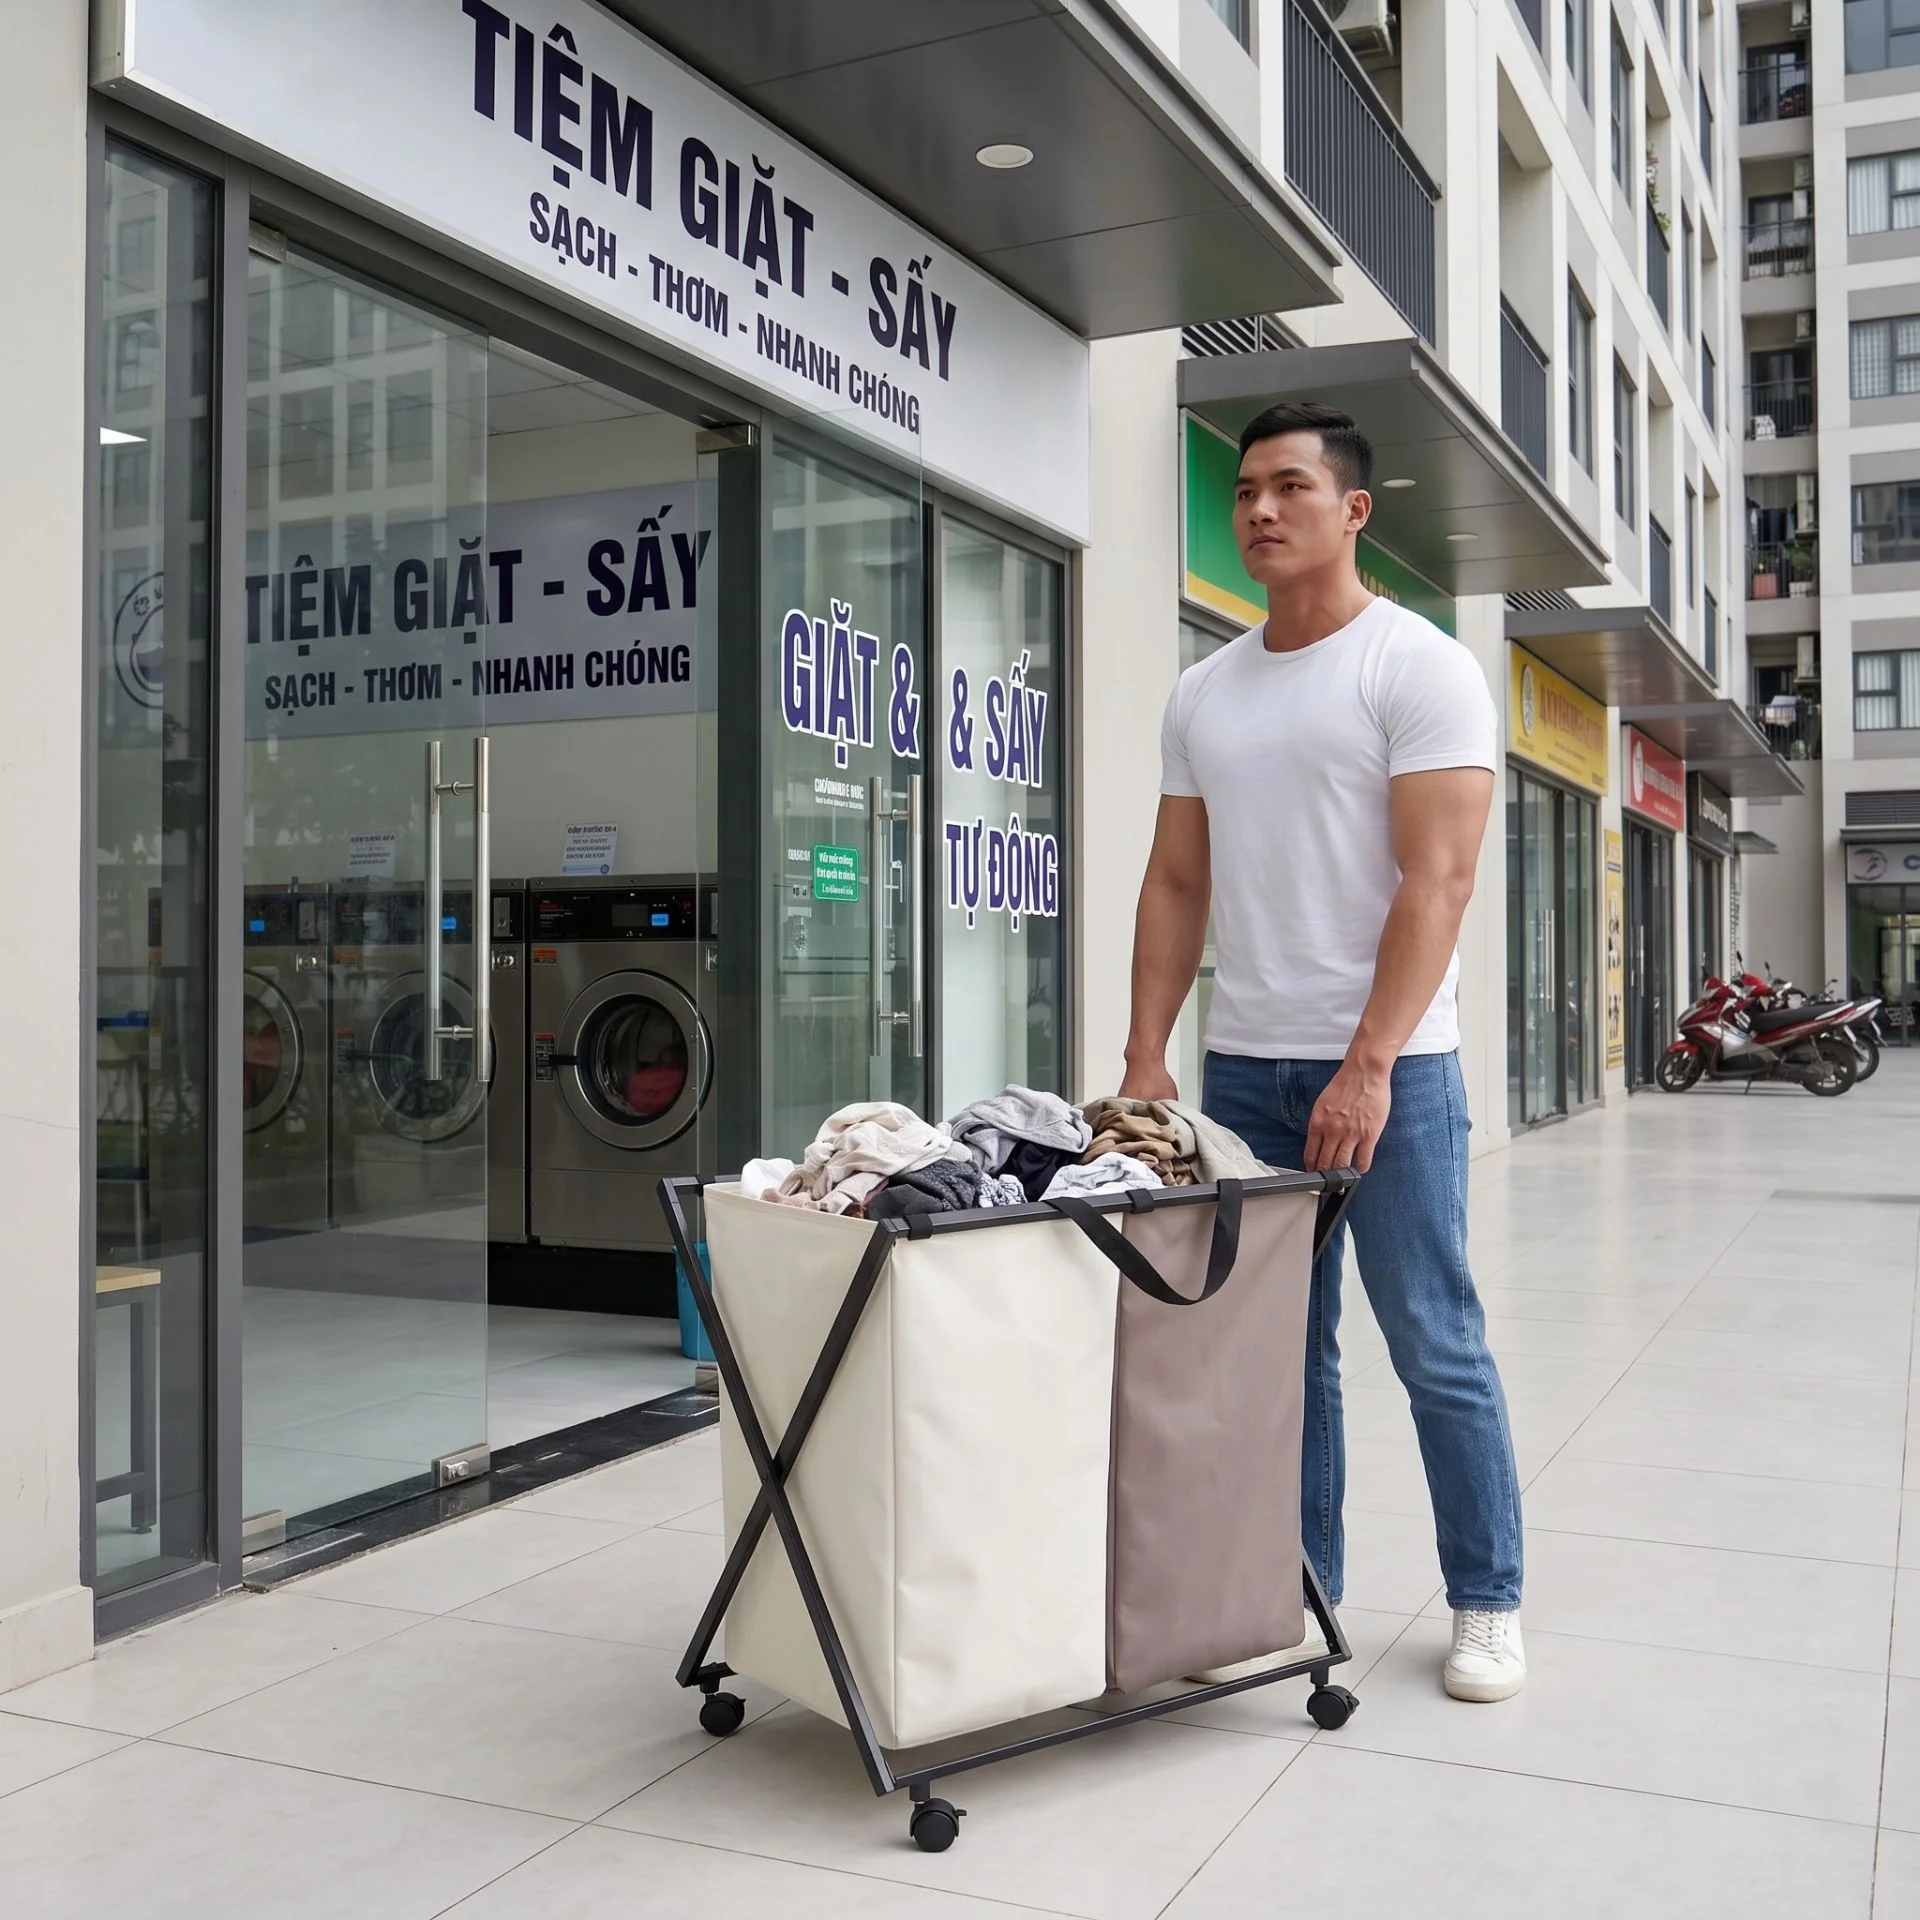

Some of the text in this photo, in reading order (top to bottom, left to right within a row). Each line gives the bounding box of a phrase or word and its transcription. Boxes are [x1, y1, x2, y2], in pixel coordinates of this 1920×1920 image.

[462, 0, 957, 382] TIỆM GIẶT - SẤY
[529, 191, 920, 435] SẠCH - THƠM - NHANH CHÓNG
[245, 504, 712, 656] TIỆM GIẶT - SẤY
[265, 671, 335, 716] SẠCH
[364, 662, 442, 703] THƠM
[472, 653, 574, 696] NHANH
[585, 639, 690, 688] CHÓNG
[781, 598, 920, 769] GIẶT &
[949, 649, 1047, 788] & SẤY
[944, 812, 1058, 933] TỰ ĐỘNG
